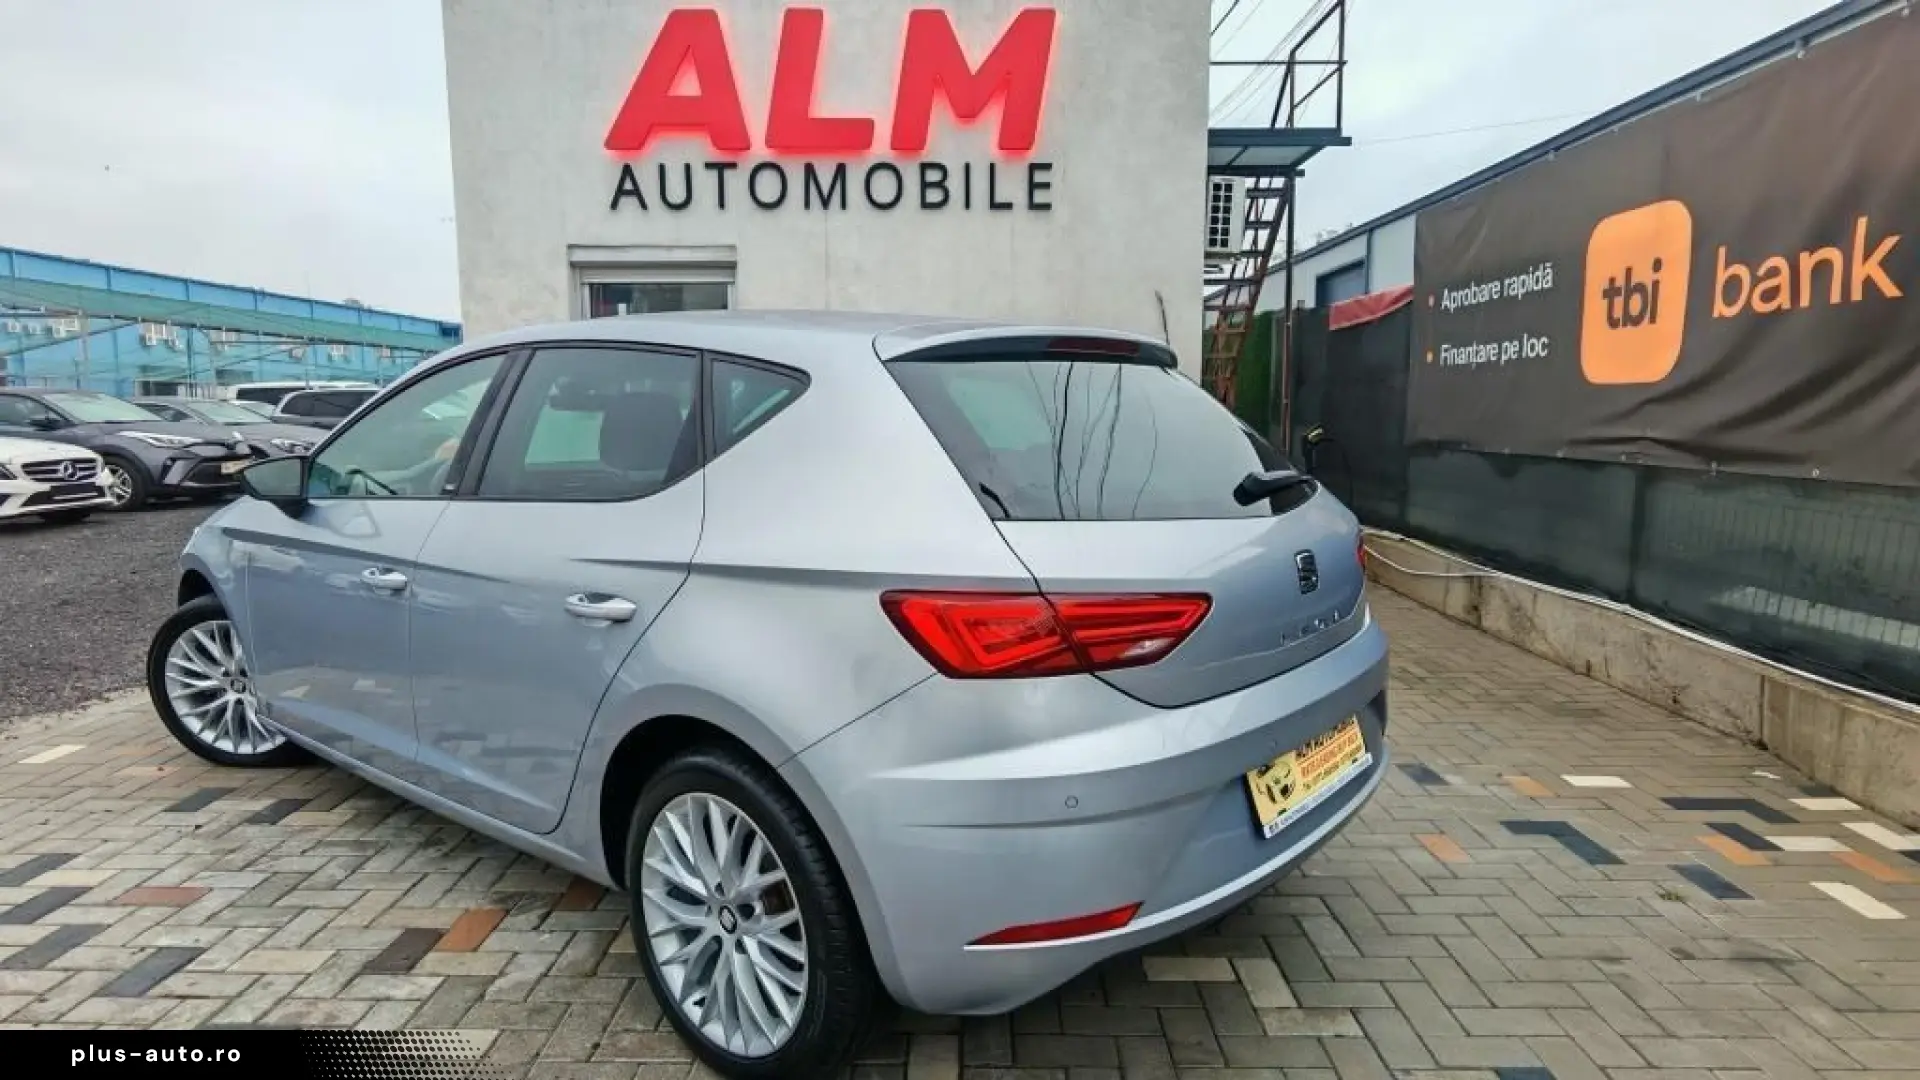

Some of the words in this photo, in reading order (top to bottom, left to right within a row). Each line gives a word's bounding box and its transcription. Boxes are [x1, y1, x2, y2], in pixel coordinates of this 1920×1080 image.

[604, 7, 1057, 151] ALM
[609, 161, 1054, 211] AUTOMOBILE
[1441, 281, 1500, 313] Aprobare
[1503, 262, 1553, 300] rapidă
[1602, 257, 1663, 330] tbi
[1711, 215, 1904, 319] bank
[1501, 340, 1520, 366] pe
[1522, 332, 1550, 359] loc
